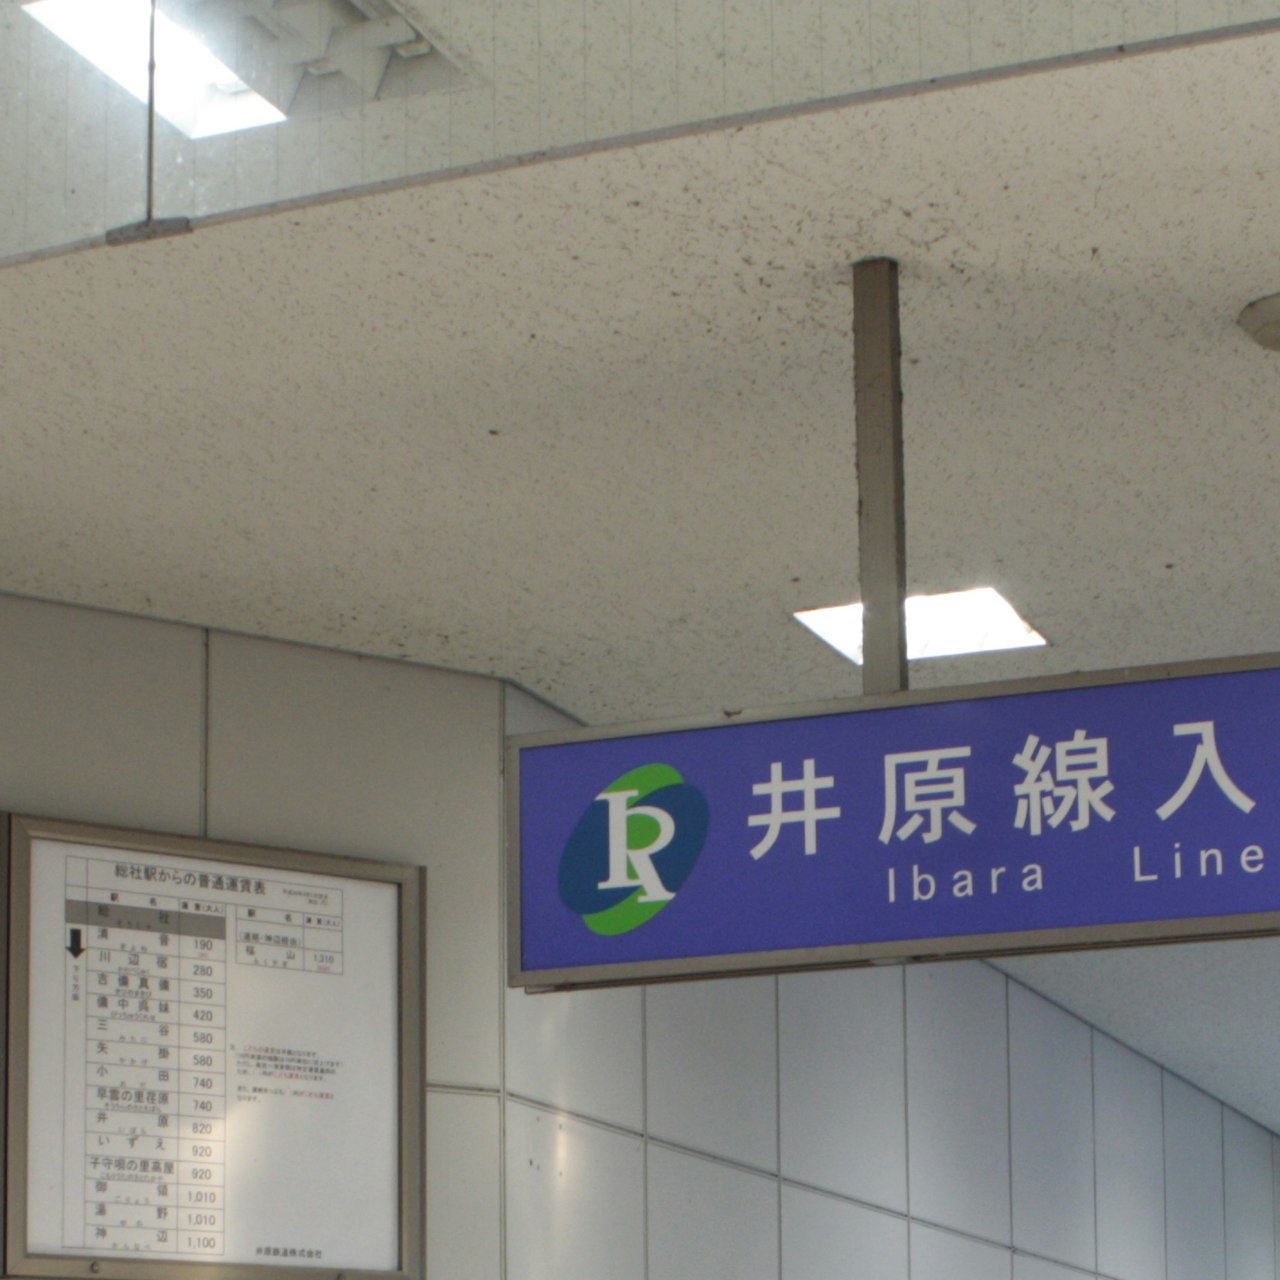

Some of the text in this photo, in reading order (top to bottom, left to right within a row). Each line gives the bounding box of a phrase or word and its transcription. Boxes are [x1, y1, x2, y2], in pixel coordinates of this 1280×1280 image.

[888, 842, 1266, 903] Ibara Line
[114, 863, 266, 896] 総社駅からの普通運賃表
[194, 939, 213, 951] 190
[193, 964, 213, 977] 280
[193, 987, 213, 1000] 350
[193, 1009, 213, 1022] 420
[193, 1031, 213, 1045] 580
[193, 1054, 213, 1067] 580
[193, 1076, 213, 1090] 740
[193, 1099, 213, 1113] 740
[192, 1122, 213, 1136] 820
[192, 1145, 213, 1158] 920
[191, 1168, 212, 1181] 920
[187, 1191, 216, 1205] 1,010
[187, 1213, 216, 1228] 1,010
[187, 1237, 216, 1250] 1,100
